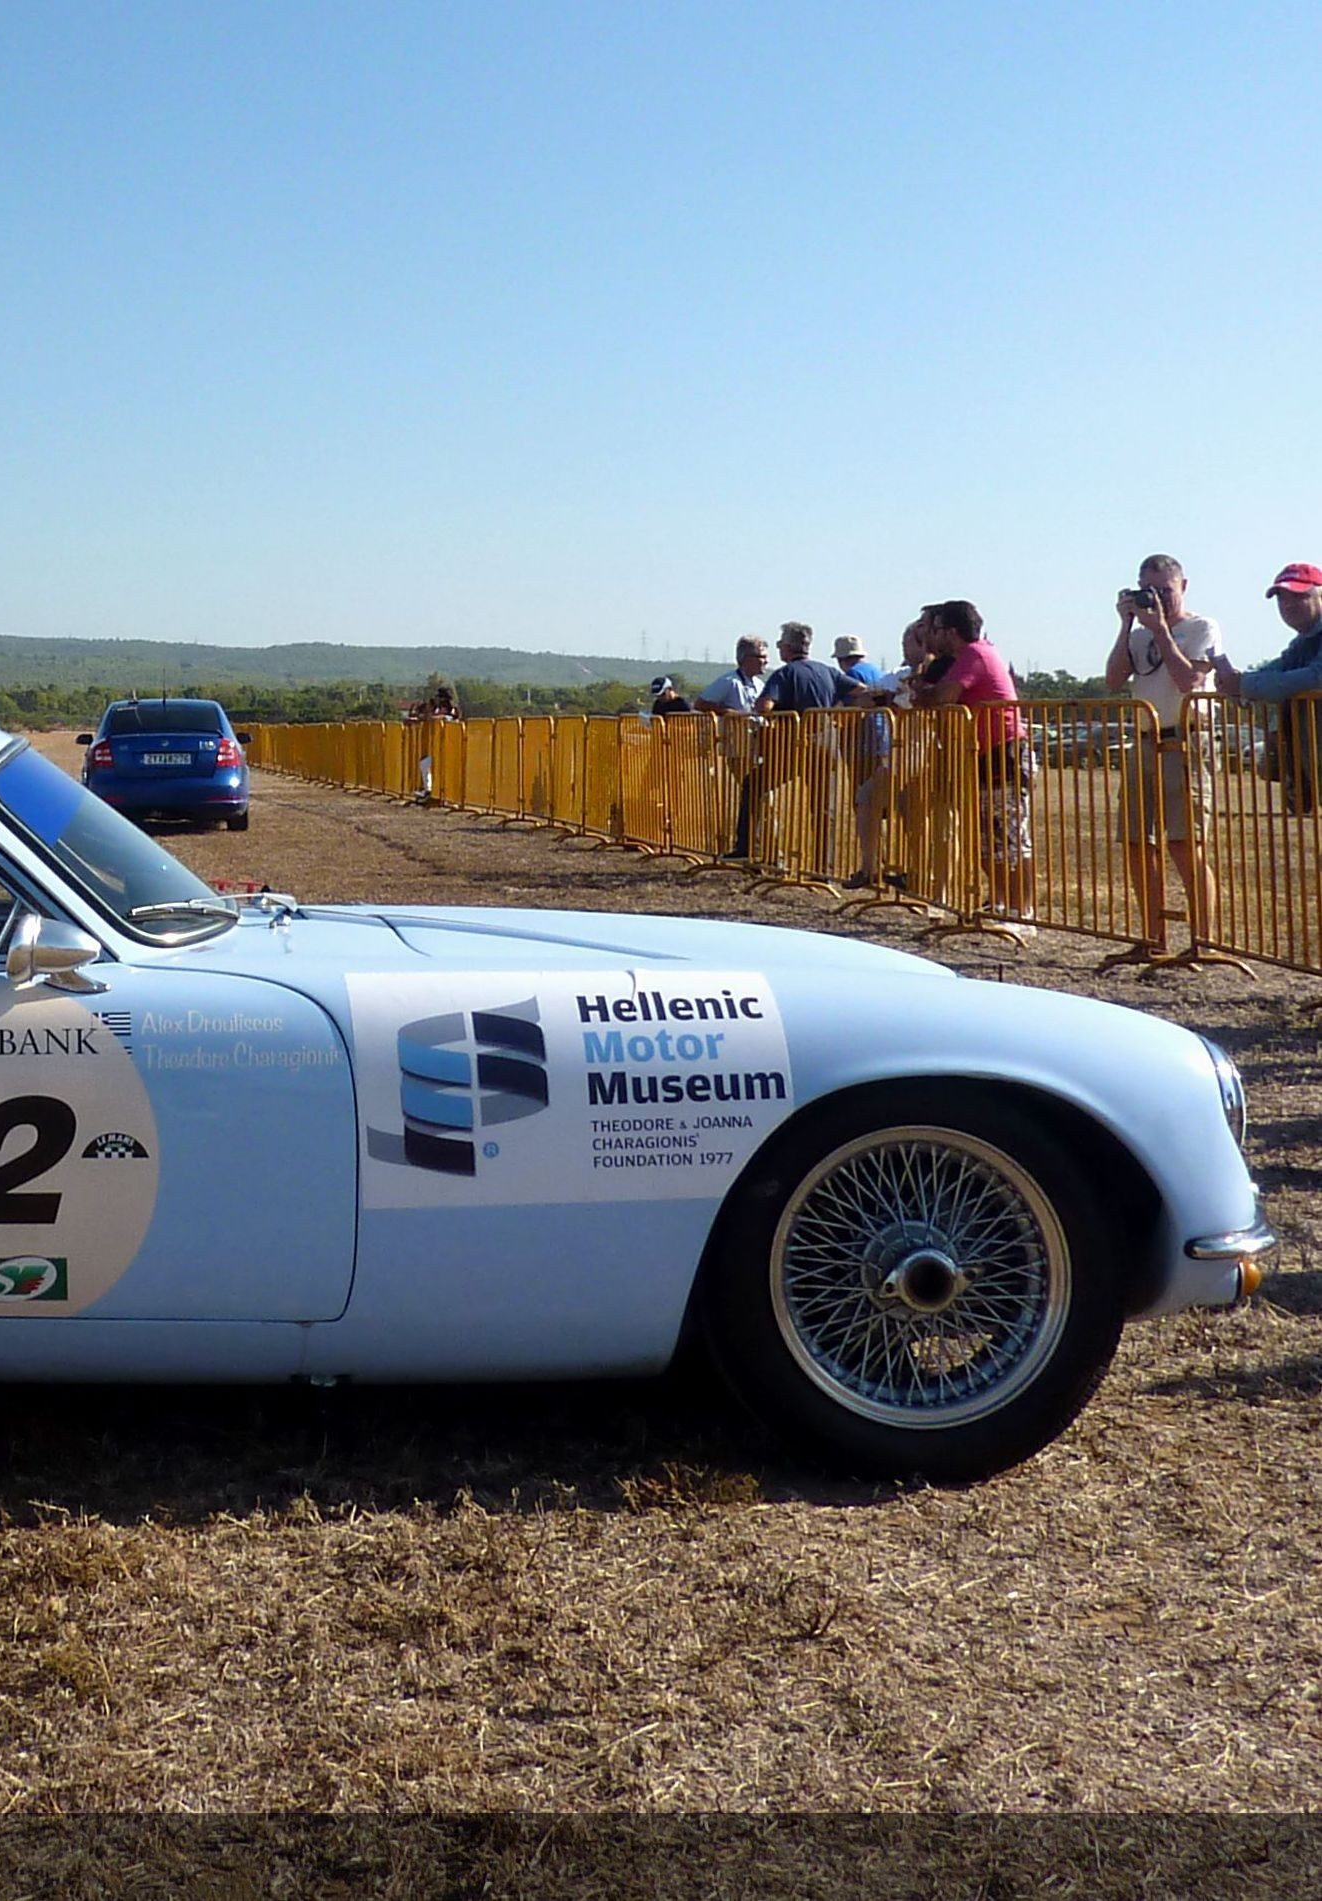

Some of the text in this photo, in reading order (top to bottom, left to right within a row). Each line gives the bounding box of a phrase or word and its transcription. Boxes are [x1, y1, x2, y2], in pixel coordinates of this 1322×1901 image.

[576, 990, 763, 1022] Hellenic
[141, 1011, 183, 1035] Alex
[583, 1029, 724, 1064] Motor
[587, 1071, 786, 1105] Museum
[591, 1118, 674, 1133] THEODORE
[693, 1116, 753, 1130] JOANNA
[593, 1152, 734, 1168] FOUNDATION 1977
